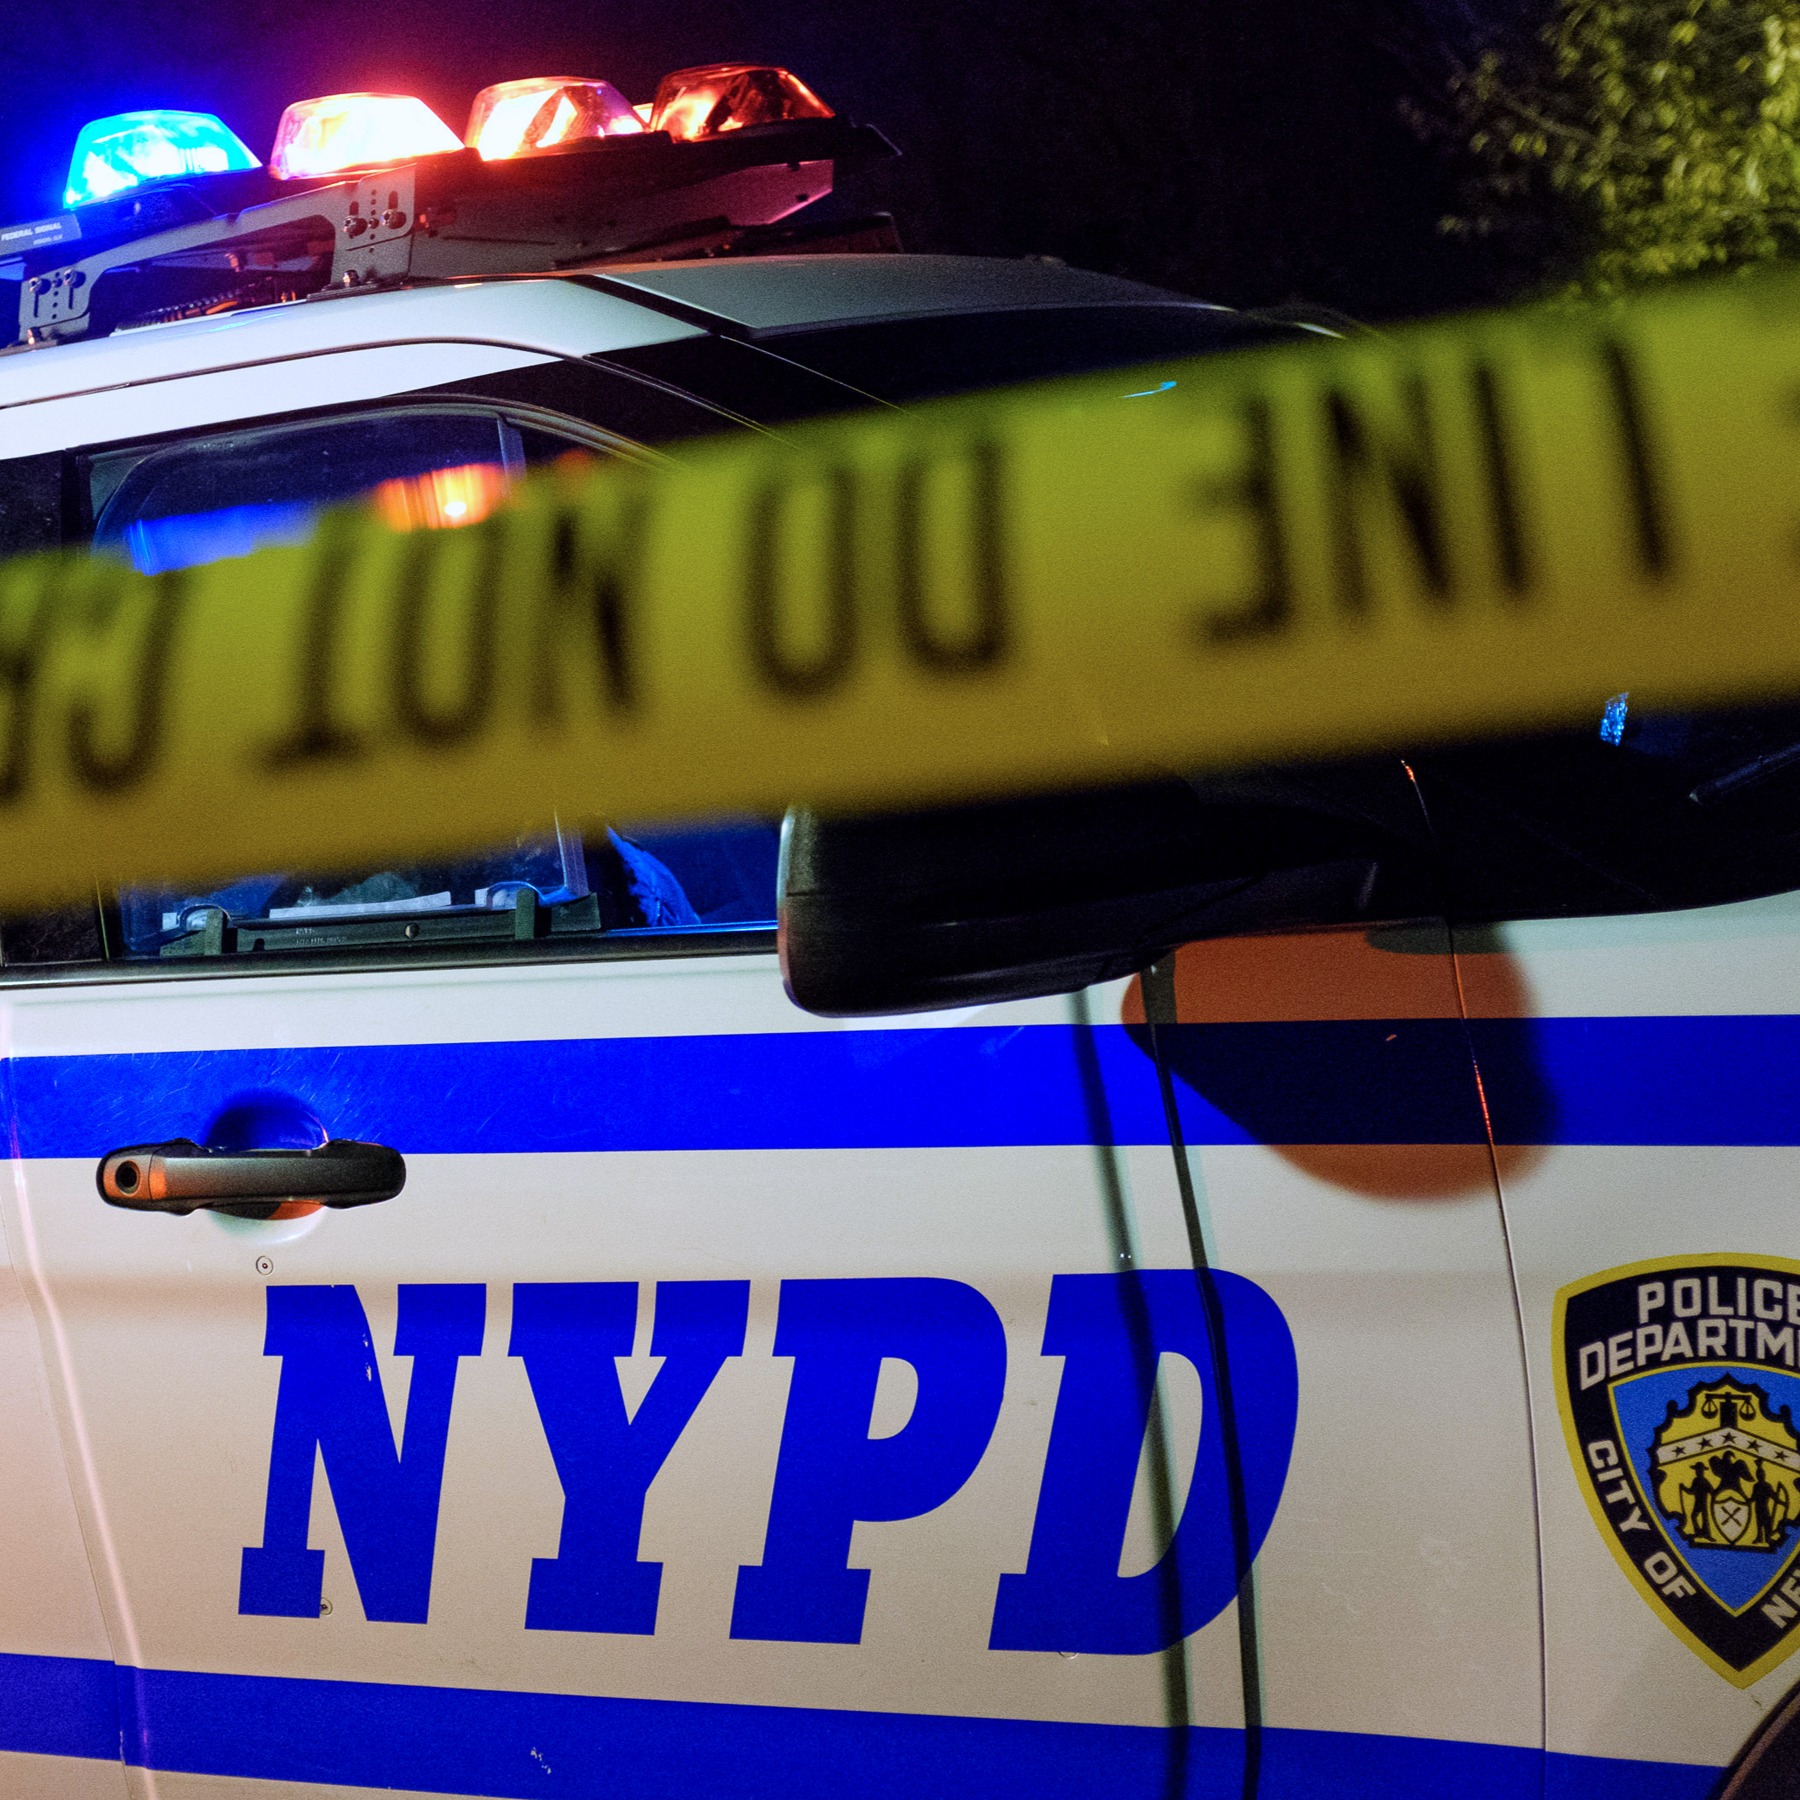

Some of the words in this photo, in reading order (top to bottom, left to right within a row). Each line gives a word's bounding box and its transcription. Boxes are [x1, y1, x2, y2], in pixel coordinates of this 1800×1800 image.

[240, 486, 655, 779] NOT
[738, 430, 1020, 708] DO
[238, 1267, 1299, 1657] NYPD
[1579, 1318, 1800, 1391] DEPARTM
[1588, 1439, 1651, 1534] CITY
[1643, 1551, 1697, 1600] OF
[1761, 1569, 1800, 1629] NE
